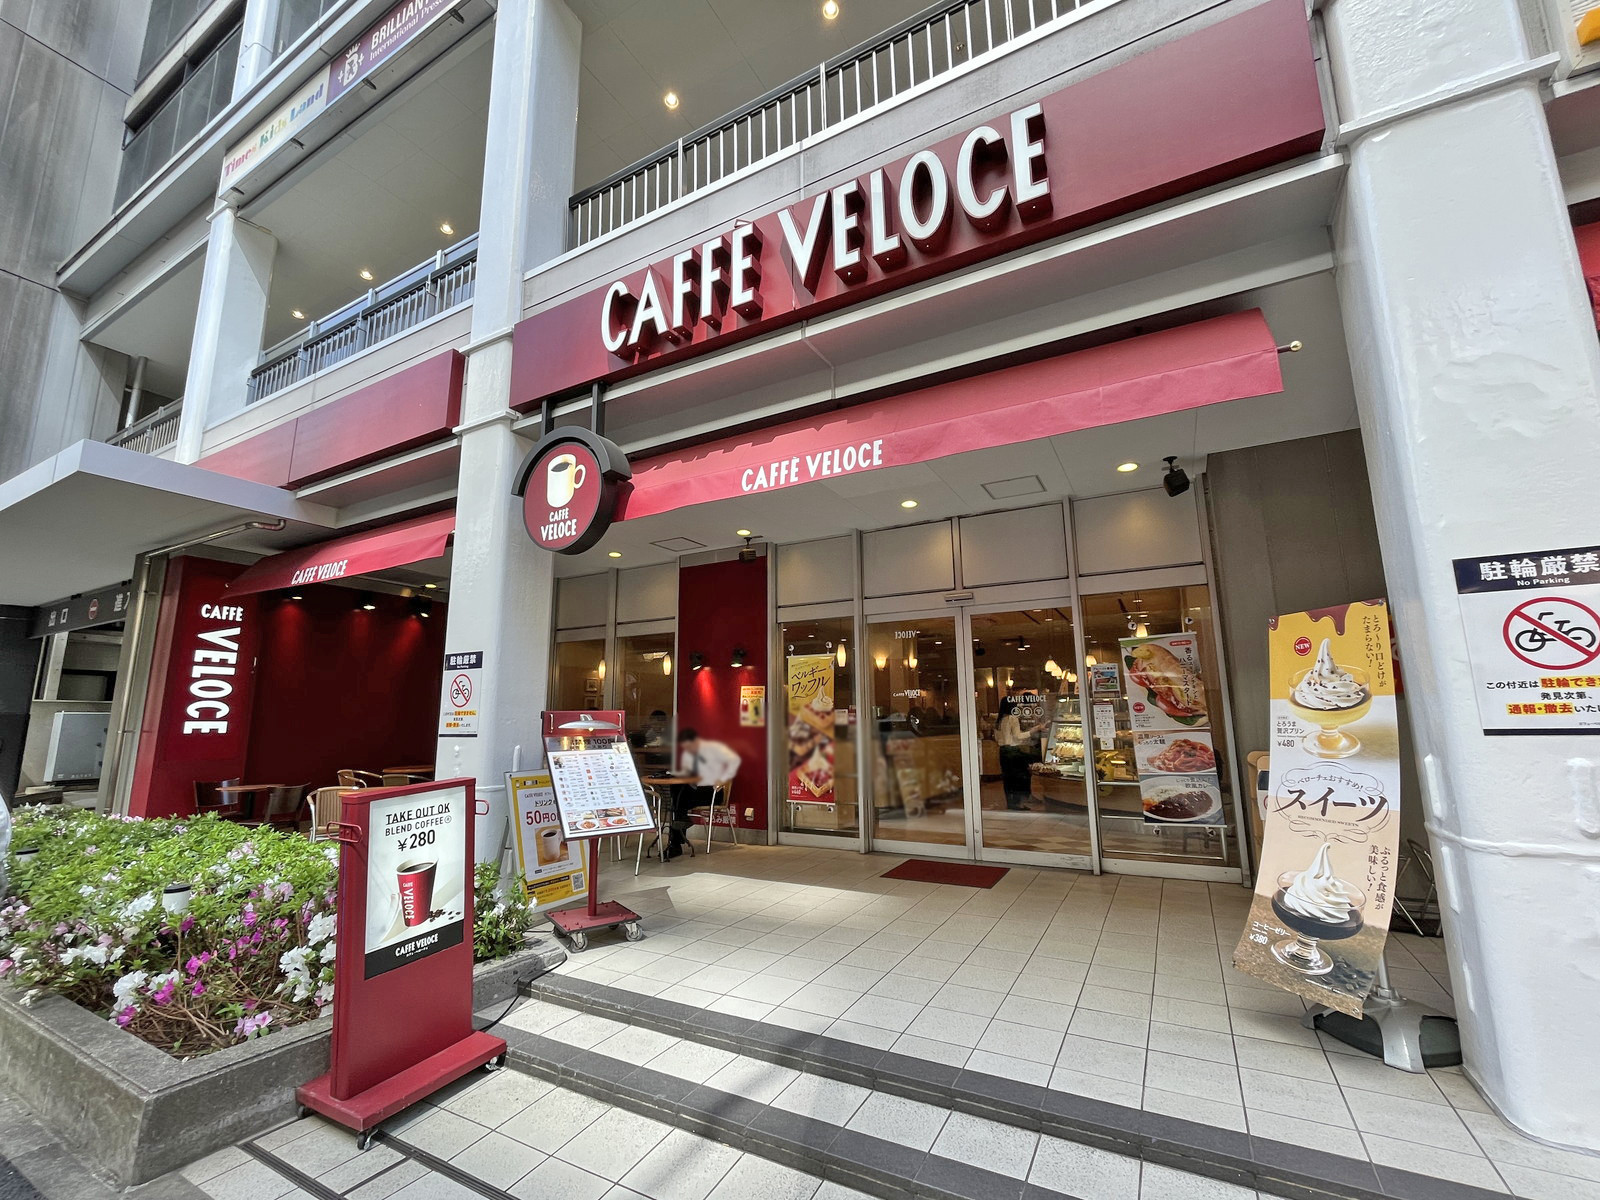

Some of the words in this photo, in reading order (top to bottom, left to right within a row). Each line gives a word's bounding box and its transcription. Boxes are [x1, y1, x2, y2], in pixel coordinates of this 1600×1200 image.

[371, 0, 429, 50] BRILLIAN
[370, 14, 419, 61] International
[259, 118, 287, 148] Kids
[290, 83, 324, 122] Land
[777, 102, 1051, 287] VELOCE
[741, 456, 800, 492] CAFFÈ
[806, 439, 883, 478] VELOCE
[541, 518, 577, 541] VELOCE
[316, 559, 348, 580] VELOCE
[1479, 552, 1600, 581] 駐輪厳禁
[1532, 577, 1571, 586] Parking
[200, 603, 244, 622] CAFFÈ
[1295, 642, 1311, 650] NEW
[183, 627, 241, 735] VELOCE
[791, 665, 827, 680] ベルギー
[791, 676, 831, 696] ワッフル
[1486, 677, 1600, 690] この付近は駐輪でき
[1025, 695, 1047, 703] VELOCE
[1541, 691, 1592, 701] 発見次第、
[1508, 703, 1600, 714] 通報・撤去いた
[1277, 739, 1295, 748] ¥480
[385, 810, 413, 825] TAKE
[415, 805, 435, 818] OUT
[437, 802, 450, 814] OK
[1273, 786, 1389, 823] スイーツ
[385, 823, 412, 837] BLEND
[397, 829, 436, 852] ¥280
[1367, 844, 1379, 892] 美味しい！
[403, 888, 415, 919] VELOCE
[1252, 920, 1292, 936] コーヒーゼリー
[415, 933, 439, 948] VELOCE
[1249, 933, 1268, 945] ¥380
